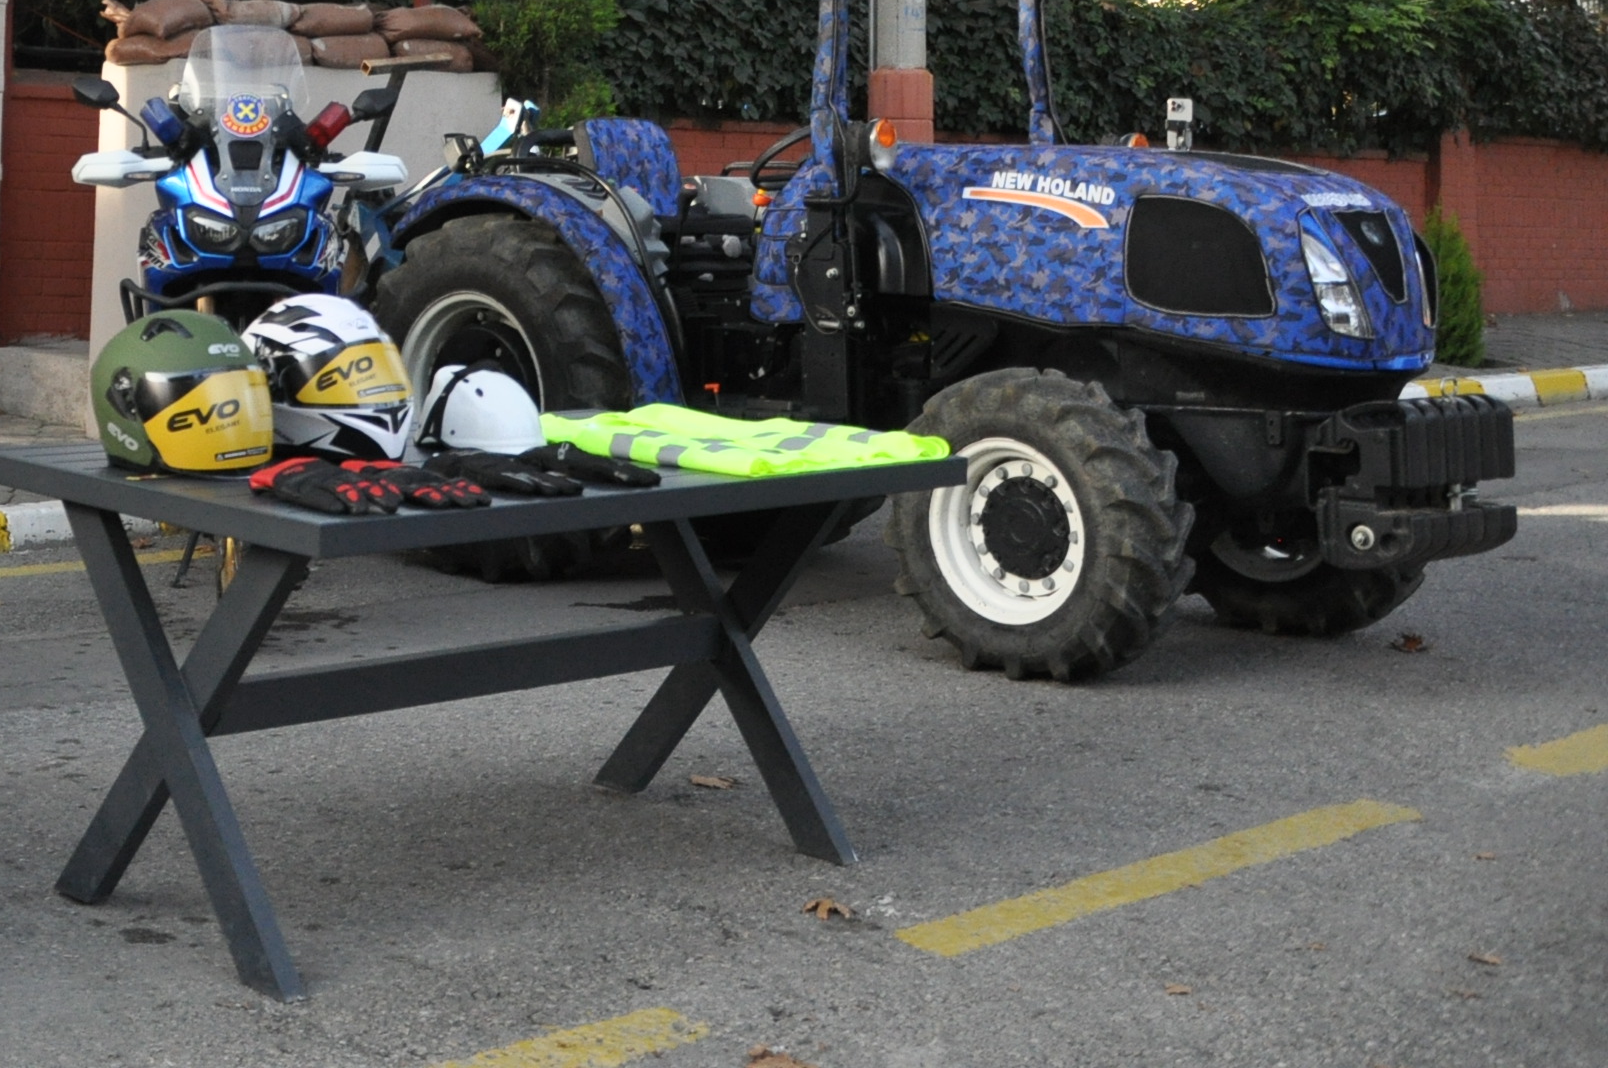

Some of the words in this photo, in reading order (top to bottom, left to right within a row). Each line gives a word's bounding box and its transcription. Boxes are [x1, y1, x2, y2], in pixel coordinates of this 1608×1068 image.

[991, 171, 1036, 191] NEW
[1036, 175, 1116, 206] HOLAND
[207, 342, 241, 355] EVO
[315, 356, 374, 392] EVO
[166, 398, 241, 433] EVO
[106, 422, 140, 452] EVO
